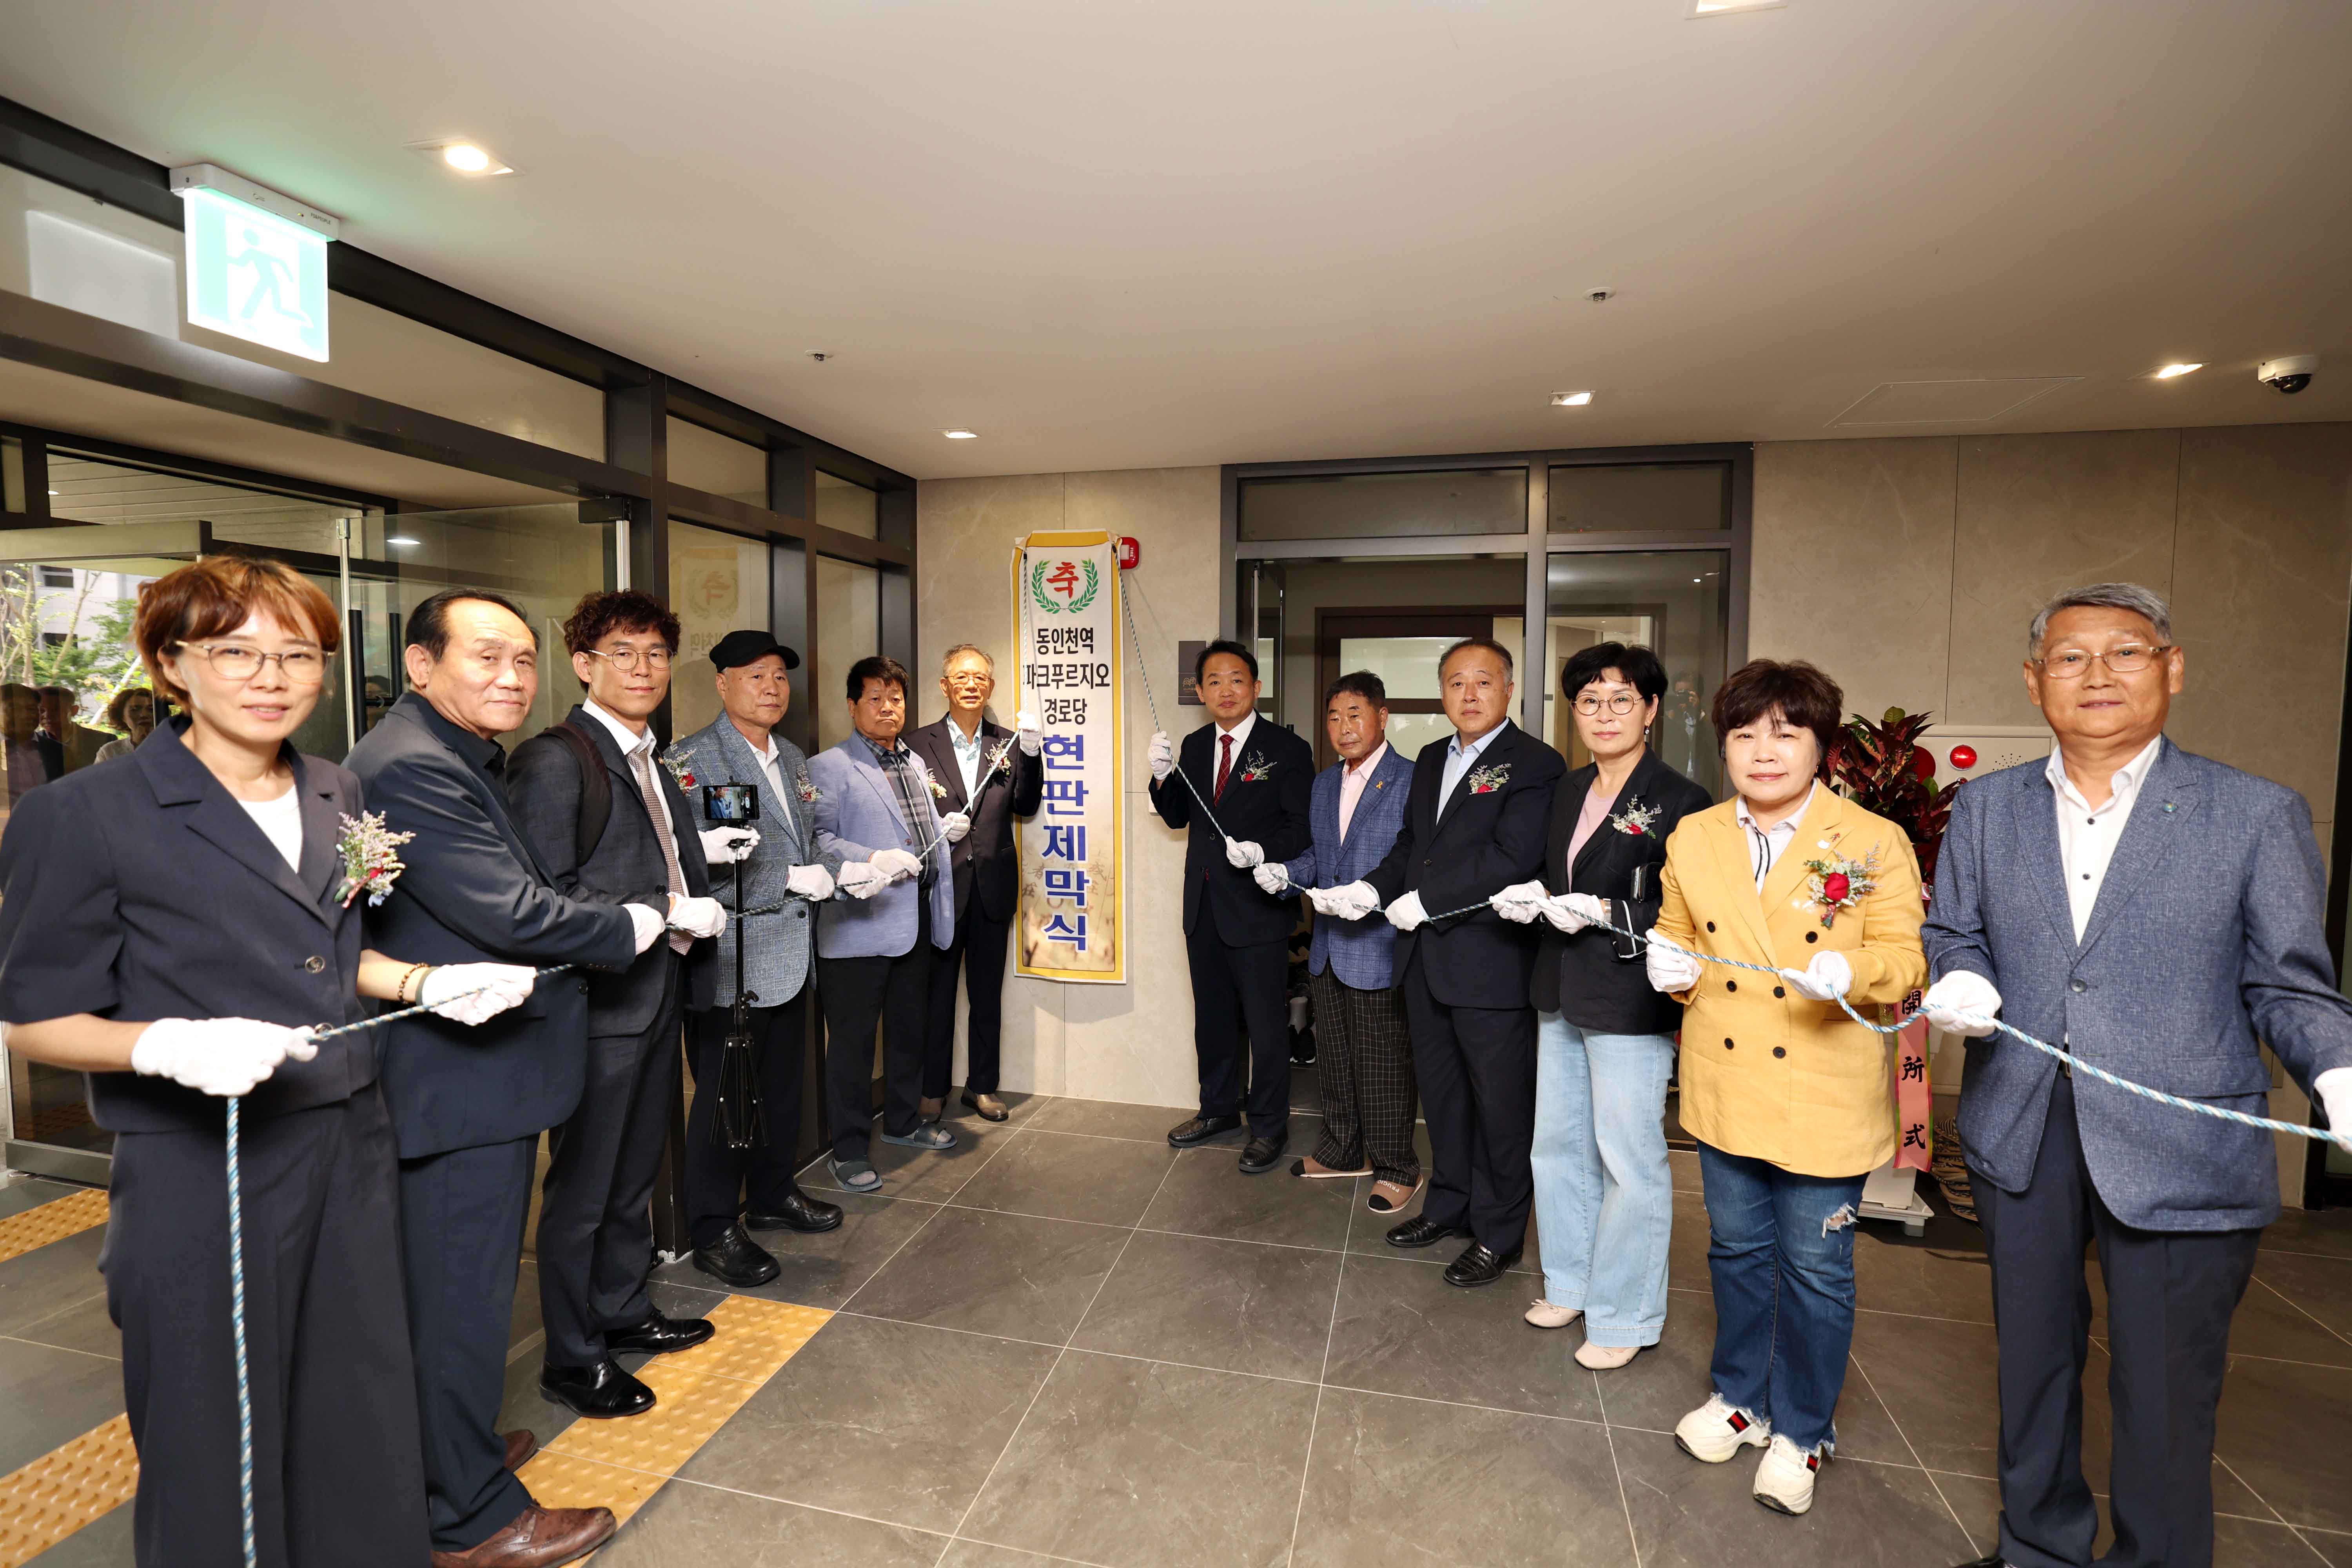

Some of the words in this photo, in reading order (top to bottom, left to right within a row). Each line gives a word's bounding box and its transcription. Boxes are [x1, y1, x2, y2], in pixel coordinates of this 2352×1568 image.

[1046, 562, 1079, 599] 축
[1036, 627, 1094, 655] 동인천역
[1024, 663, 1110, 689] 파크푸르지오
[1045, 699, 1087, 725] 경로당
